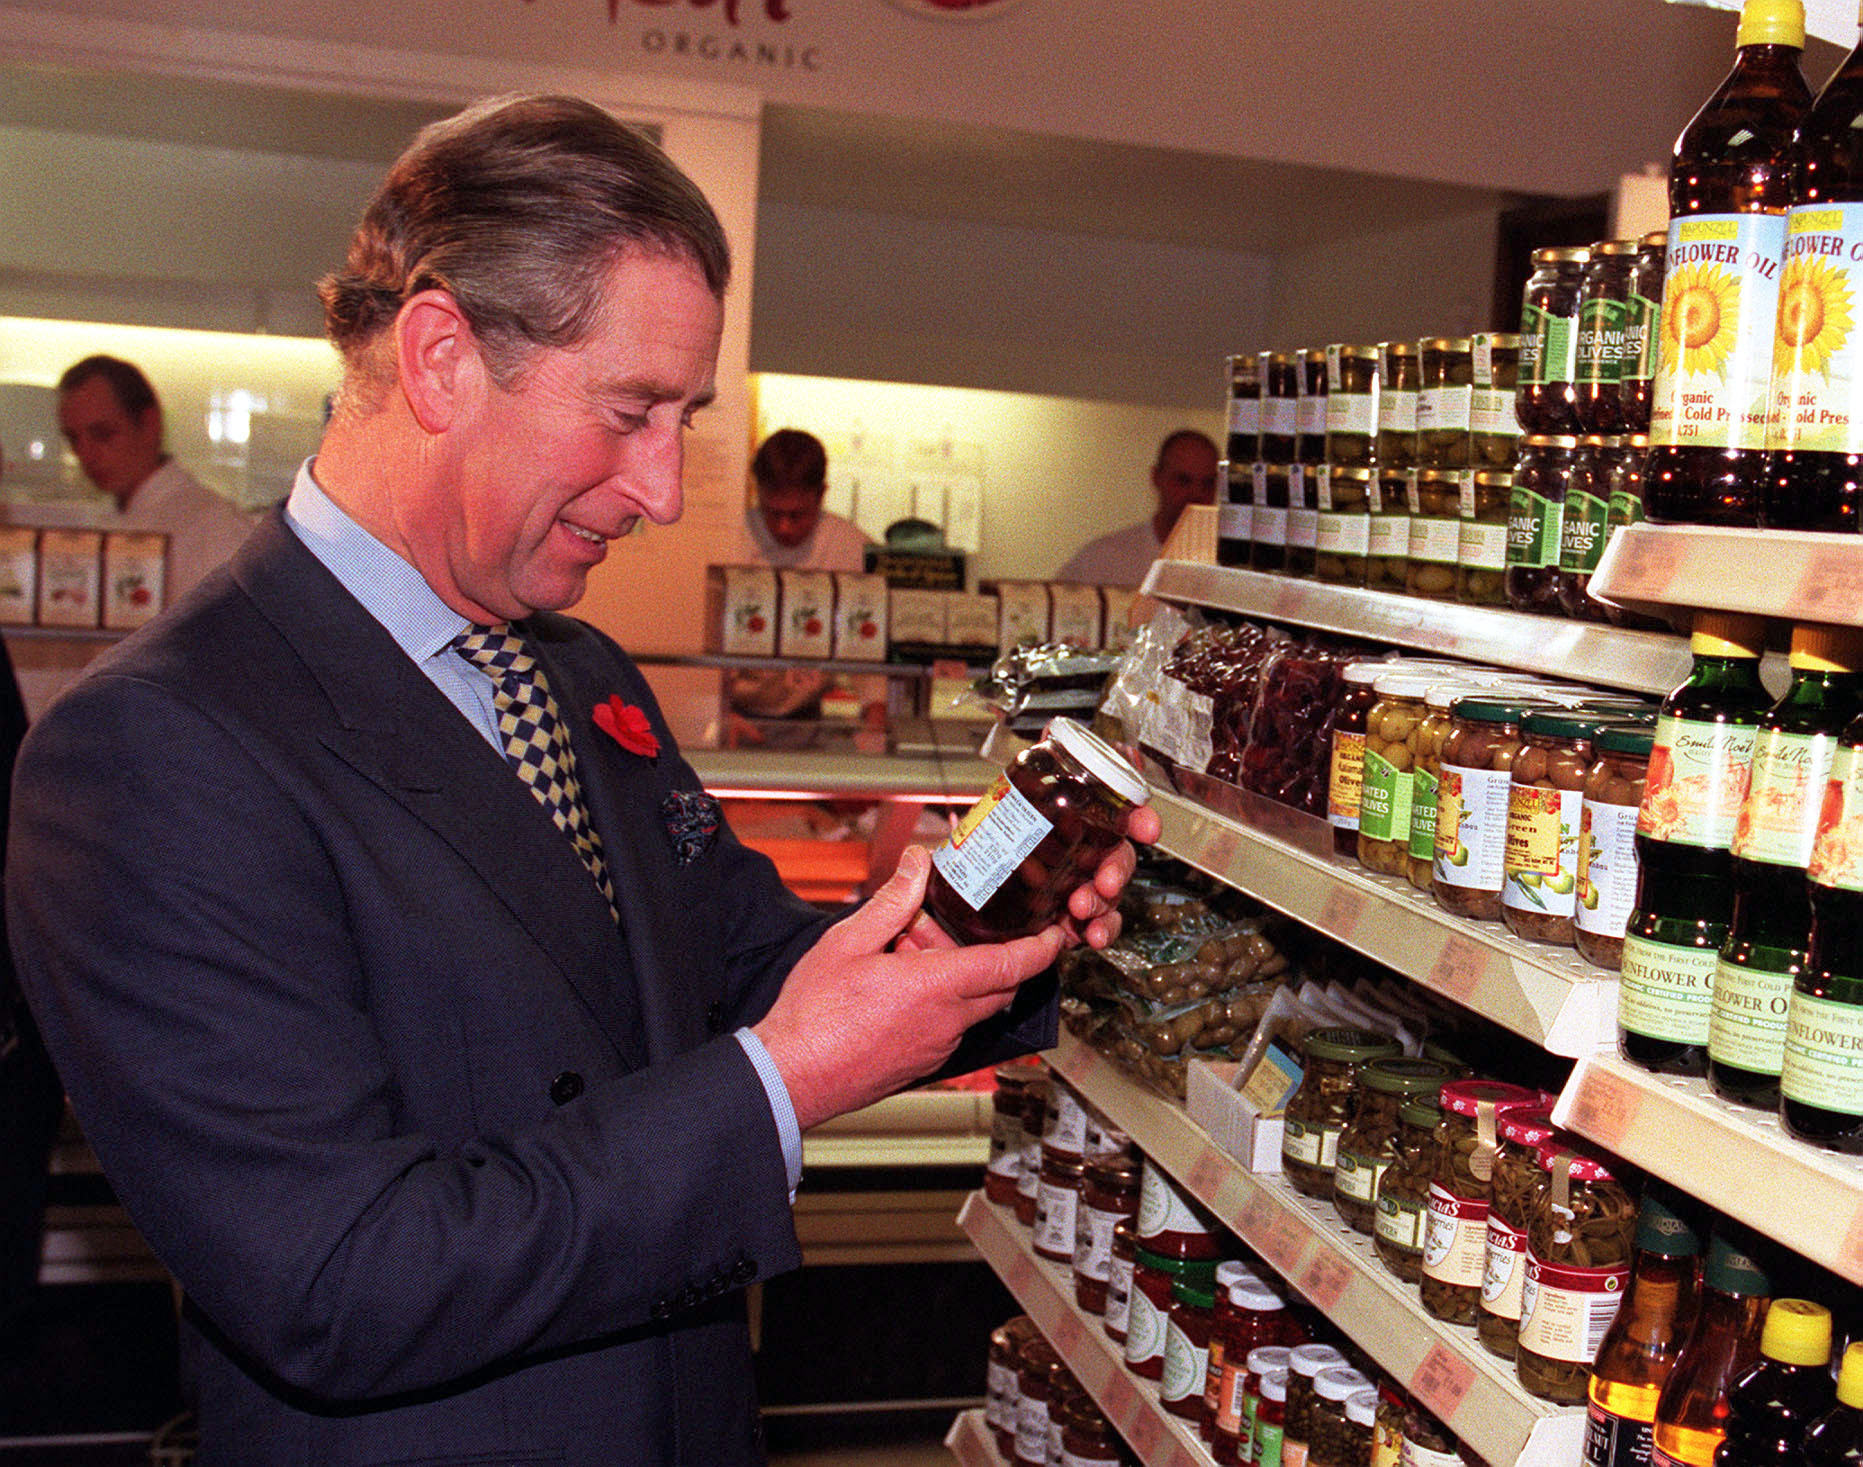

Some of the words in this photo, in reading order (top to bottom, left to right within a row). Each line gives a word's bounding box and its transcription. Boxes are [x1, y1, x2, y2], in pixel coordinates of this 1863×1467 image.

[641, 30, 822, 72] ORGANIC
[1685, 406, 1712, 420] Cold
[1795, 408, 1816, 423] old
